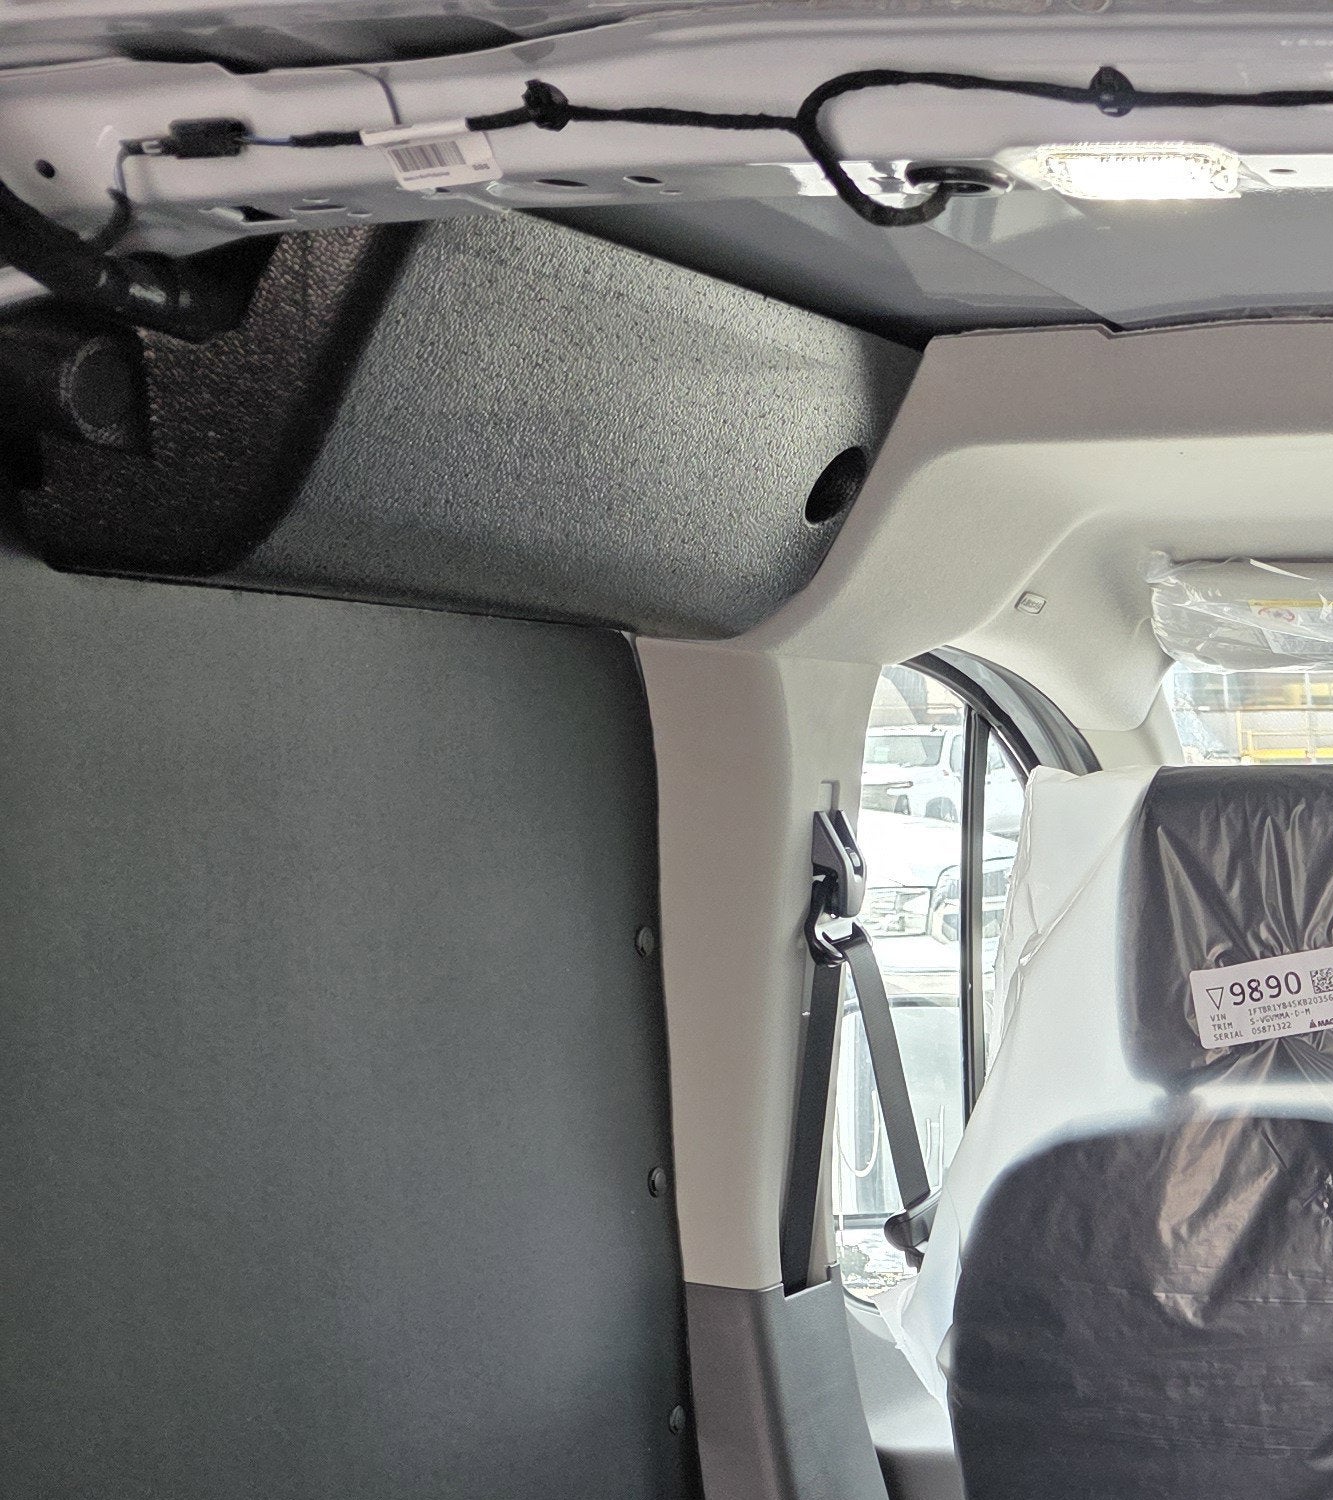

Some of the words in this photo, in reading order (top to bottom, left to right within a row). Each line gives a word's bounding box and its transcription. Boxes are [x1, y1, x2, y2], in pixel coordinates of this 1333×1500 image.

[1229, 971, 1302, 1006] 9890
[1209, 1013, 1227, 1022] VIN
[1212, 1022, 1234, 1031] TRIM
[1213, 1030, 1244, 1041] SERIAL
